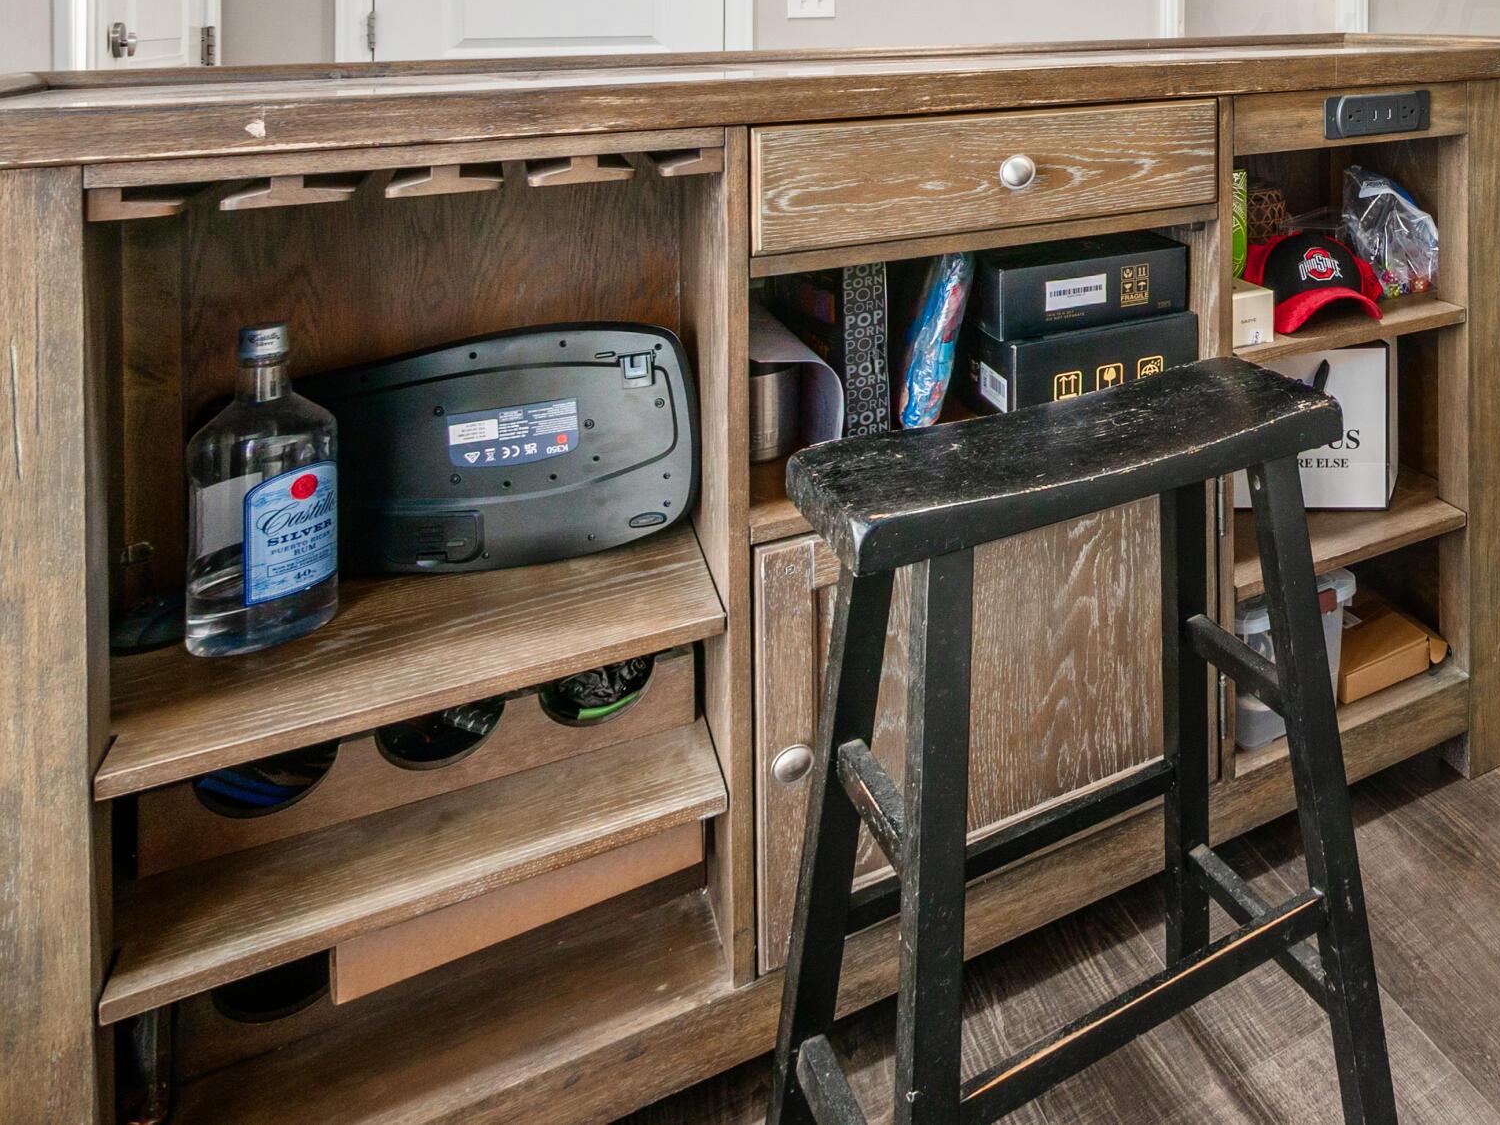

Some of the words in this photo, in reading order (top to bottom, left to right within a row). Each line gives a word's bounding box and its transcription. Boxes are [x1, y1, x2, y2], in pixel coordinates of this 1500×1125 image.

[843, 262, 884, 280] POP
[843, 275, 883, 290] CORN
[843, 285, 883, 304] POP
[1121, 291, 1149, 302] FRAGILE
[843, 299, 884, 316] CORN
[845, 310, 884, 330] POP
[844, 322, 885, 340] CORN
[845, 334, 885, 355] POP
[845, 347, 887, 365] CORN
[846, 359, 885, 380] POP
[846, 372, 887, 390] CORN
[847, 383, 886, 405] POP
[847, 396, 888, 414] CORN
[848, 407, 887, 430] POP
[848, 421, 889, 438] CORN
[1316, 457, 1349, 469] ELSE
[267, 518, 333, 548] SILVER
[271, 540, 309, 556] PUERTO
[294, 543, 317, 556] RUM
